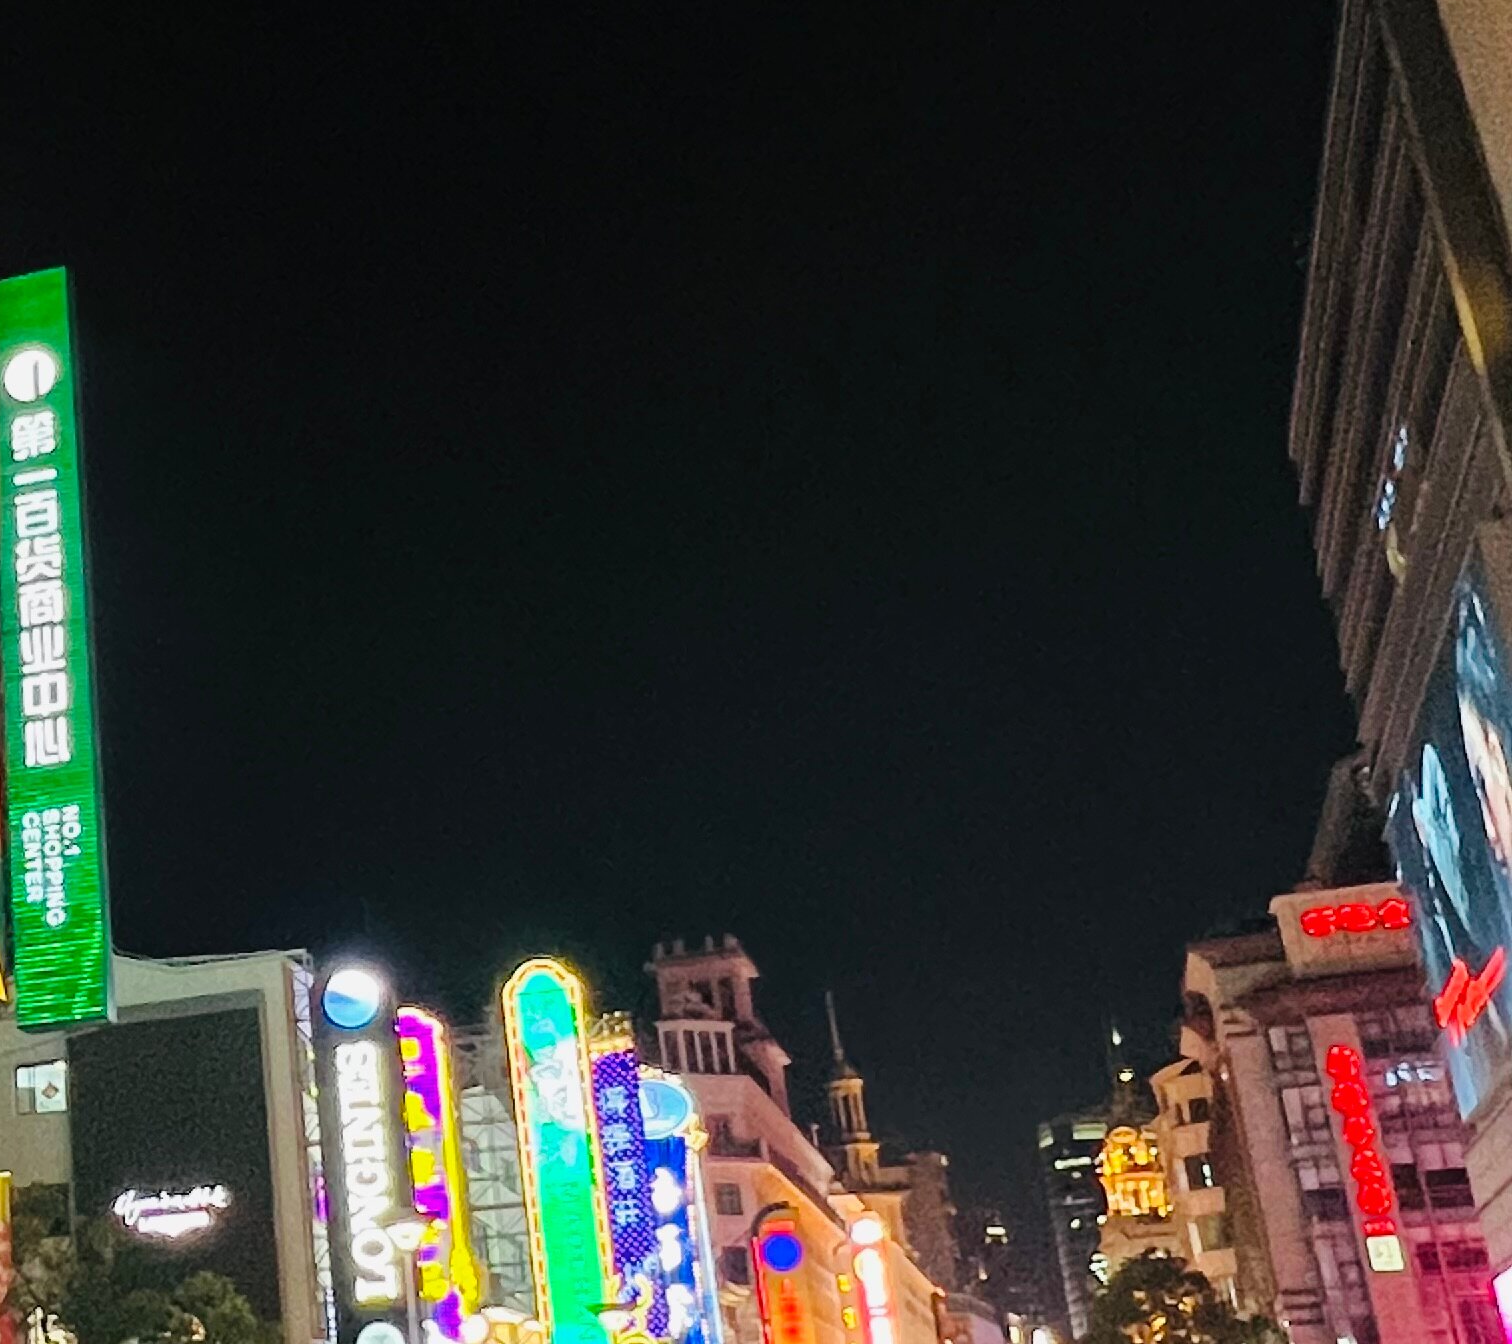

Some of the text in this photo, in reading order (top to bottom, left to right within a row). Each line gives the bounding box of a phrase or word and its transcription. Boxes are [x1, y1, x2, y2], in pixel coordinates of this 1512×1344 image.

[11, 410, 71, 767] 第一百货商业中心
[22, 811, 43, 903] CENTER
[42, 808, 66, 928] SHOPPING
[334, 1040, 401, 1303] LONGINES
